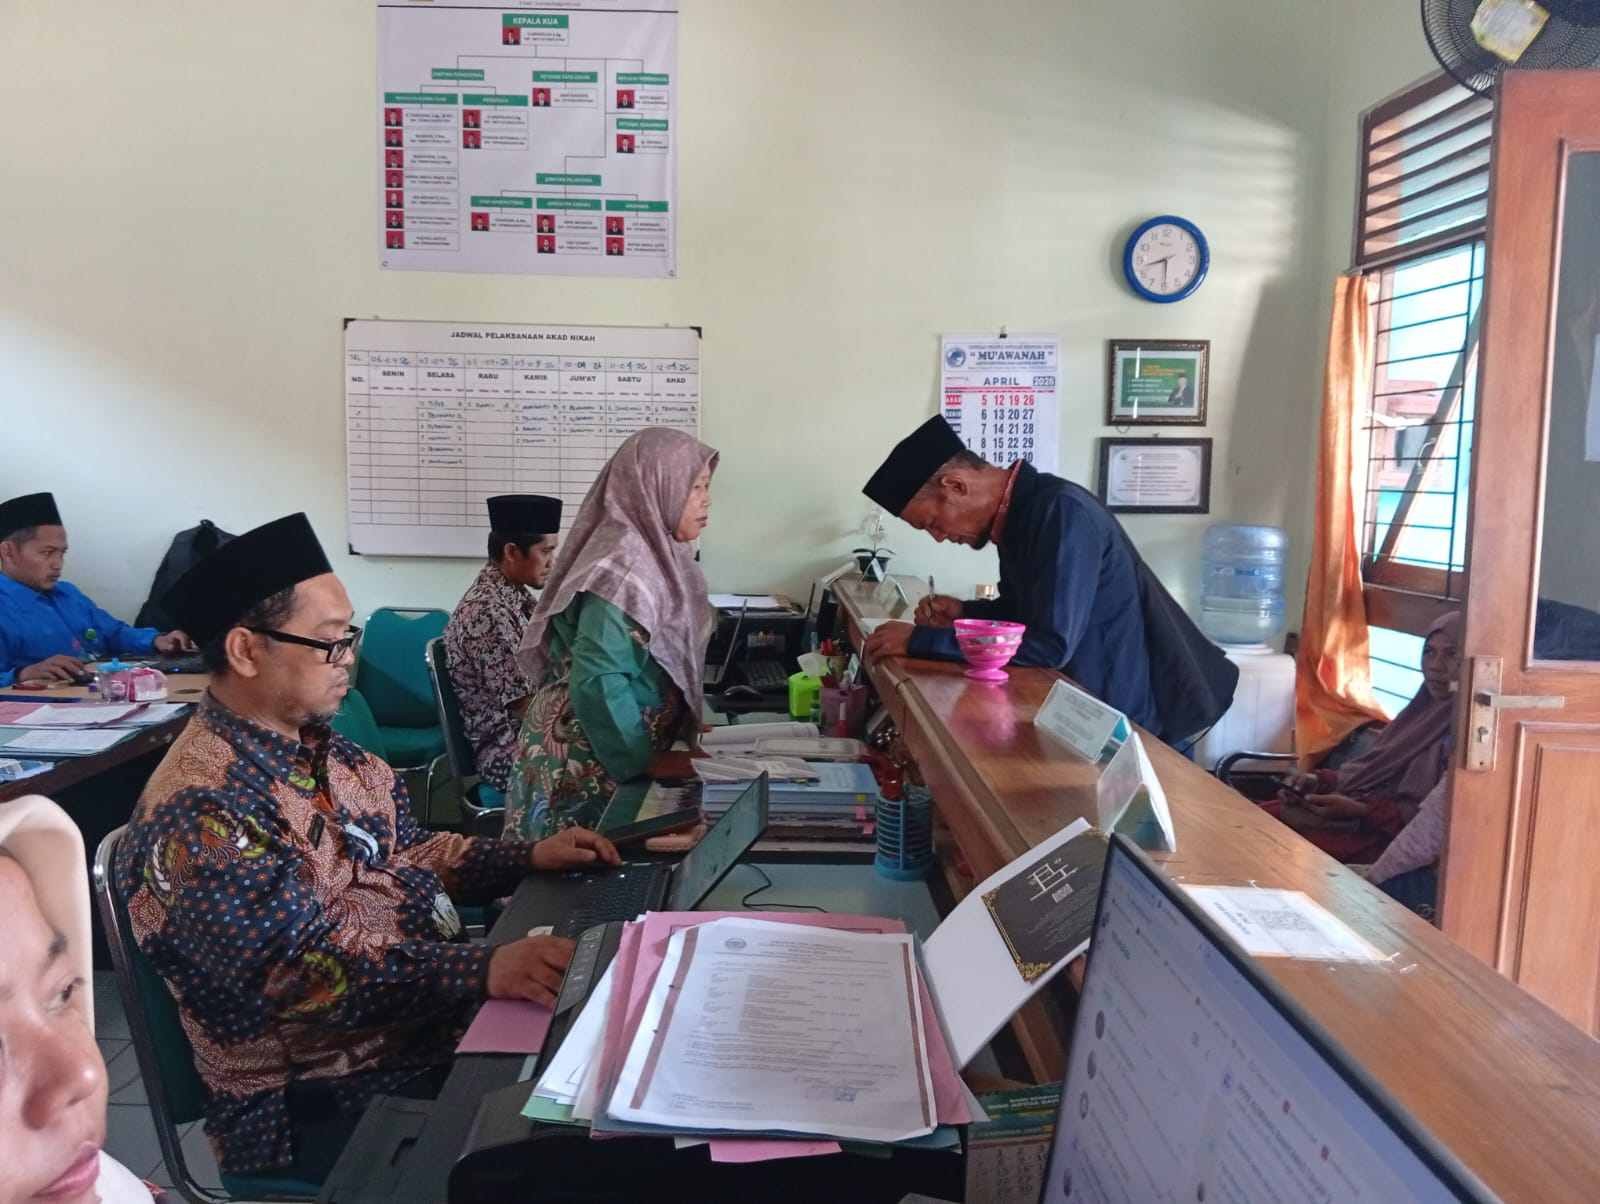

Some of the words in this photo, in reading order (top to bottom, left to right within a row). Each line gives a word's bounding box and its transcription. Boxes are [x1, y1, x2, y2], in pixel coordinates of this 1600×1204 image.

[513, 17, 541, 25] KEPALA
[450, 331, 483, 339] JADWAL
[485, 332, 544, 340] PELAKSANAAN
[570, 334, 596, 342] NIKAH
[978, 351, 1045, 360] MU'AWANAH
[983, 377, 1020, 386] APRIL
[982, 395, 987, 406] 5
[994, 395, 1005, 406] 12
[1009, 395, 1019, 406] 19
[1023, 395, 1034, 406] 26
[981, 409, 987, 420] 6
[993, 409, 1005, 420] 13
[1008, 409, 1019, 420] 20
[1022, 409, 1034, 420] 27
[981, 423, 986, 434] 7
[993, 423, 1004, 434] 14
[1008, 423, 1019, 434] 21
[1023, 423, 1034, 434] 28
[967, 438, 971, 448] 1
[981, 438, 986, 448] 8
[993, 438, 1003, 448] 15
[1007, 438, 1018, 448] 22
[1022, 438, 1034, 448] 29
[993, 452, 1003, 462] 16
